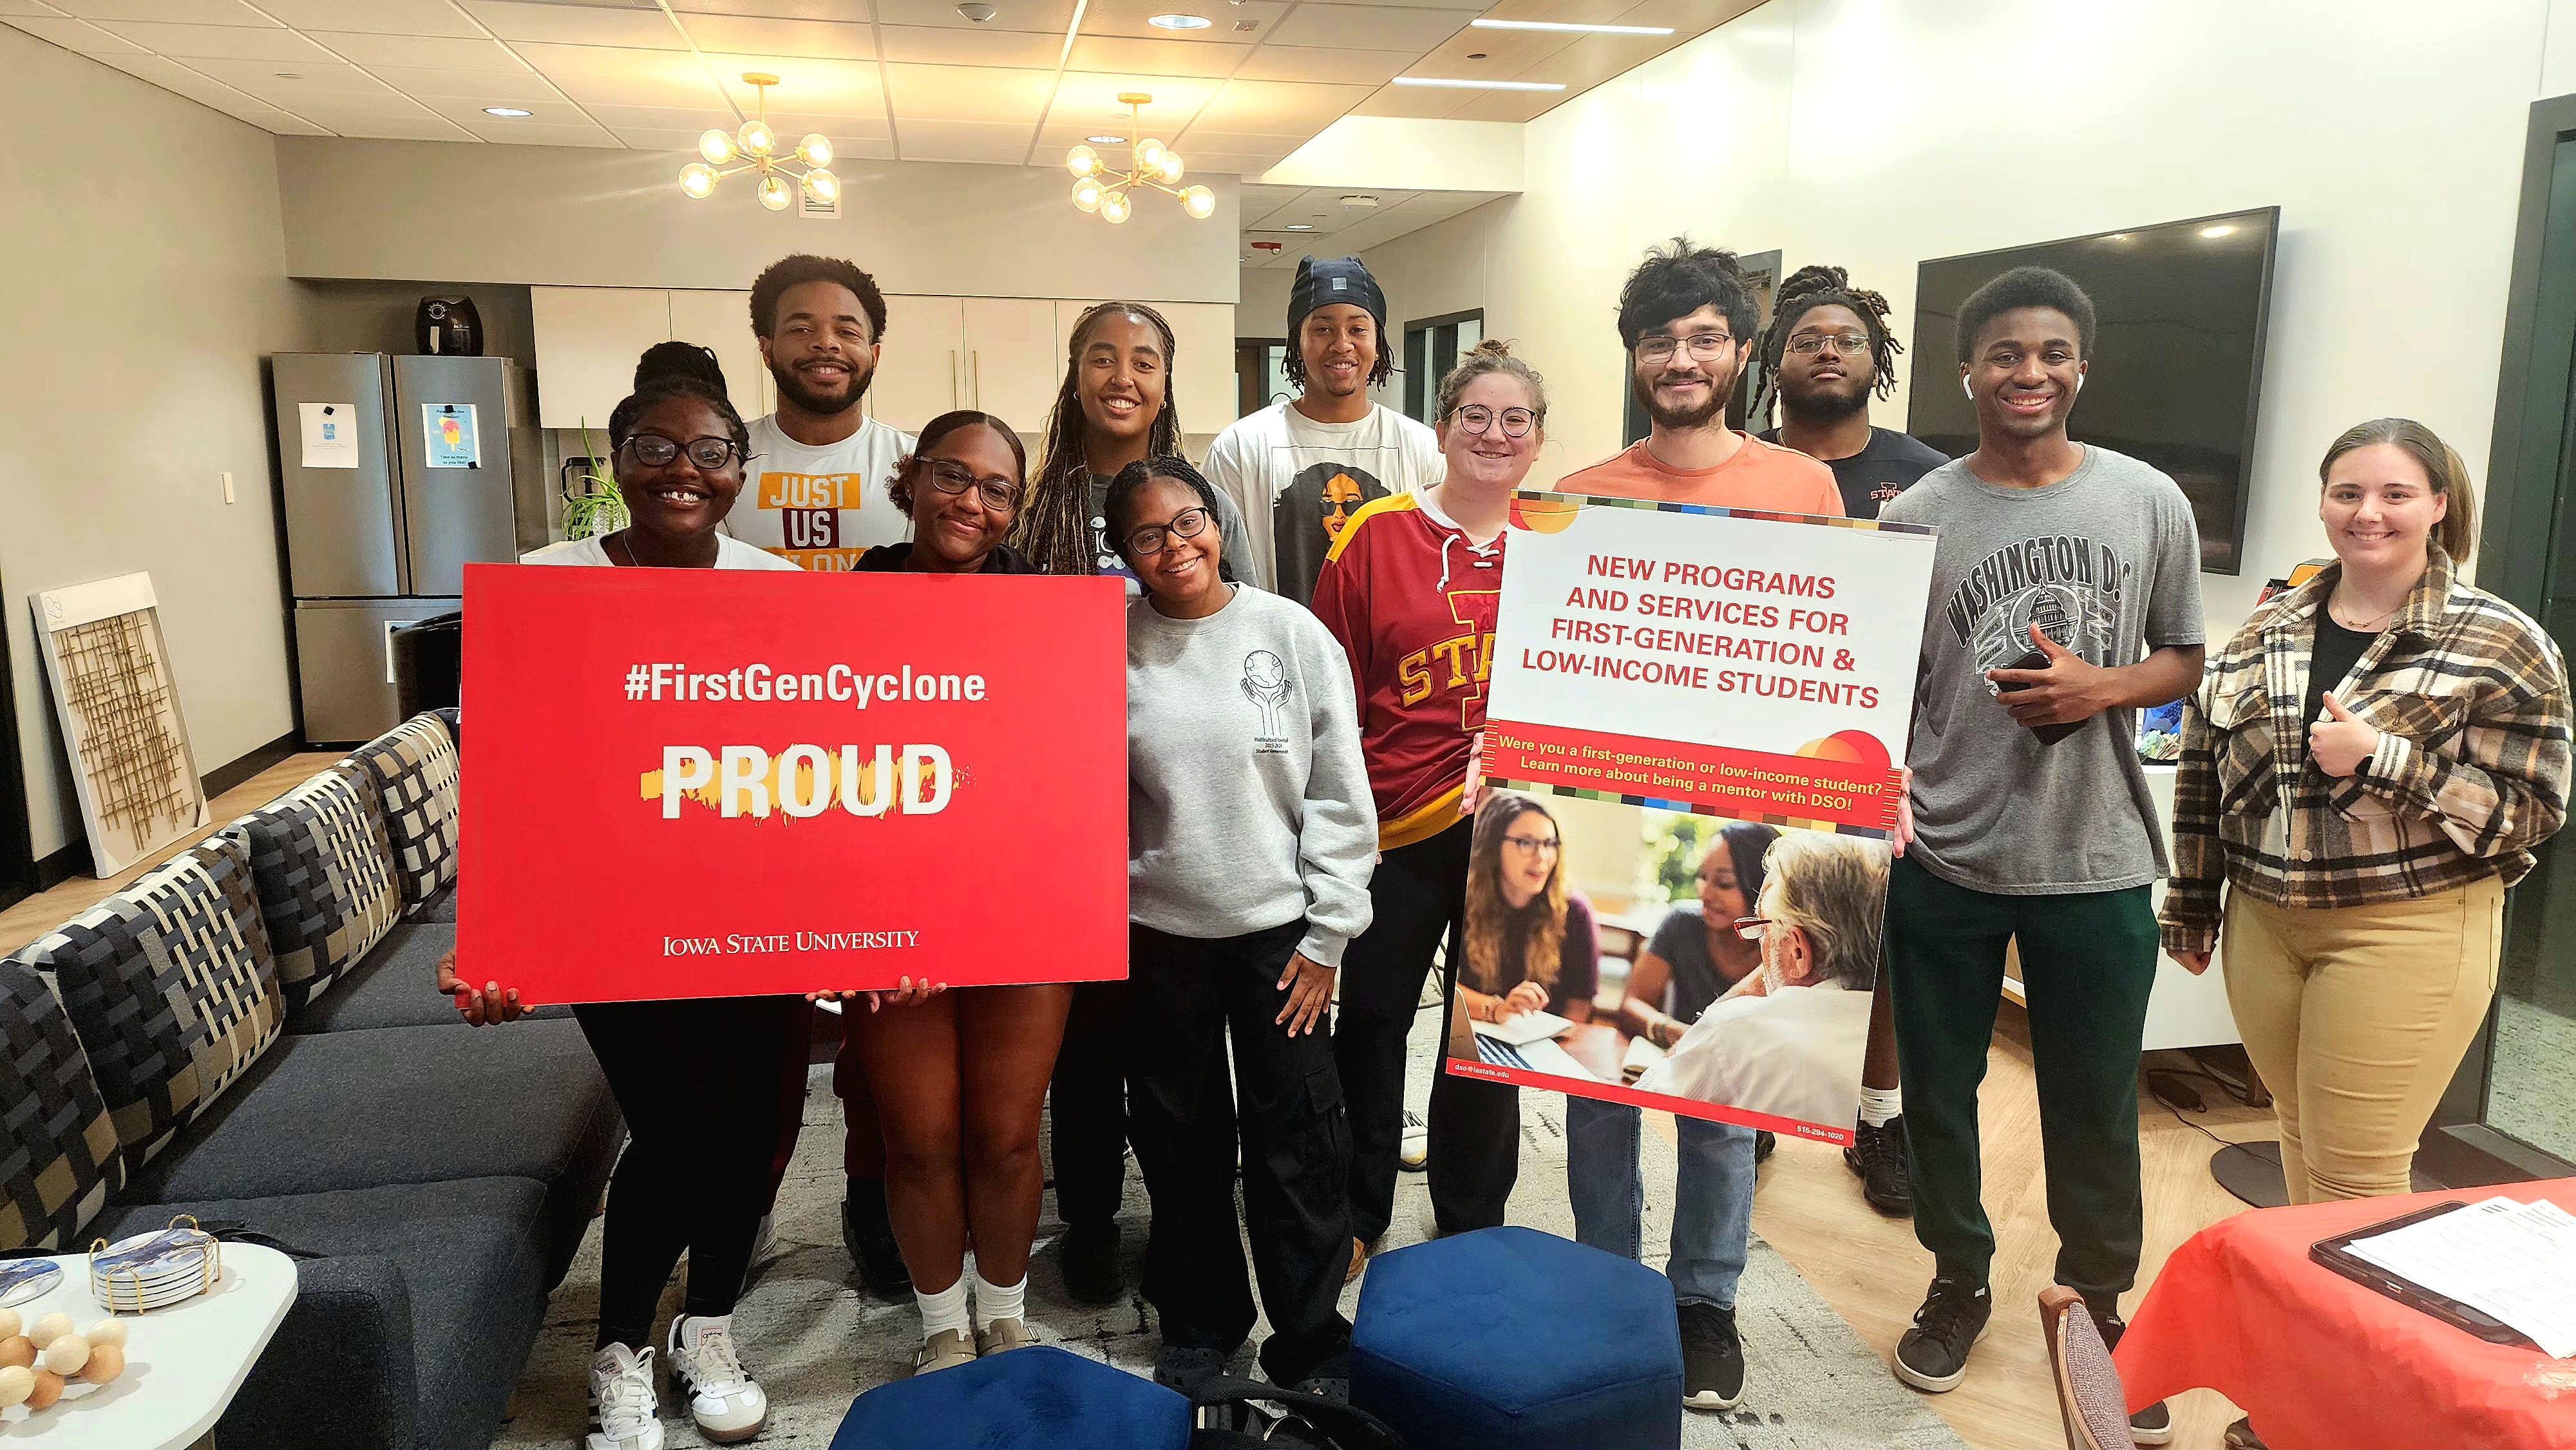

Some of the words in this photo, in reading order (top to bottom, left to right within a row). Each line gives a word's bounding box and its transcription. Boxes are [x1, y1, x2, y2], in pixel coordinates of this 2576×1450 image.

[770, 476, 848, 507] JUST
[1870, 489, 1902, 500] STAT
[791, 511, 831, 547] US
[1587, 554, 1656, 582] NEW
[1663, 562, 1836, 599] PROGRAMS
[1946, 535, 2094, 648] WASHINGTON
[1566, 587, 1629, 613] AND
[1637, 593, 1778, 628] SERVICES
[1788, 610, 1849, 636] FOR
[1551, 618, 1824, 668] FIRST-GENERATION
[1832, 648, 1855, 672] &
[624, 663, 987, 710] #FirstGenCyclone
[1522, 648, 1708, 690] LOW-INCOME
[1717, 671, 1879, 710] STUDENTS
[662, 744, 952, 819] PROUD
[1499, 735, 1535, 751] Were
[1539, 743, 1566, 755] you
[1569, 748, 1578, 757] a
[1582, 746, 1696, 771] first-generation
[1700, 764, 1716, 774] or
[1720, 762, 1809, 786] low-income
[1813, 777, 1882, 796] student?
[1520, 755, 1559, 772] Learn
[1564, 764, 1602, 777] more
[1605, 767, 1649, 782] about
[1653, 772, 1694, 792] being
[1698, 783, 1707, 791] a
[1711, 782, 1767, 799] mentor
[1771, 789, 1806, 805] with
[1810, 794, 1852, 811] DSO!
[662, 936, 721, 957] IOWA
[726, 933, 790, 954] STATE
[795, 930, 919, 951] UNIVERSITY
[1797, 1125, 1844, 1140] 515-294-1020
